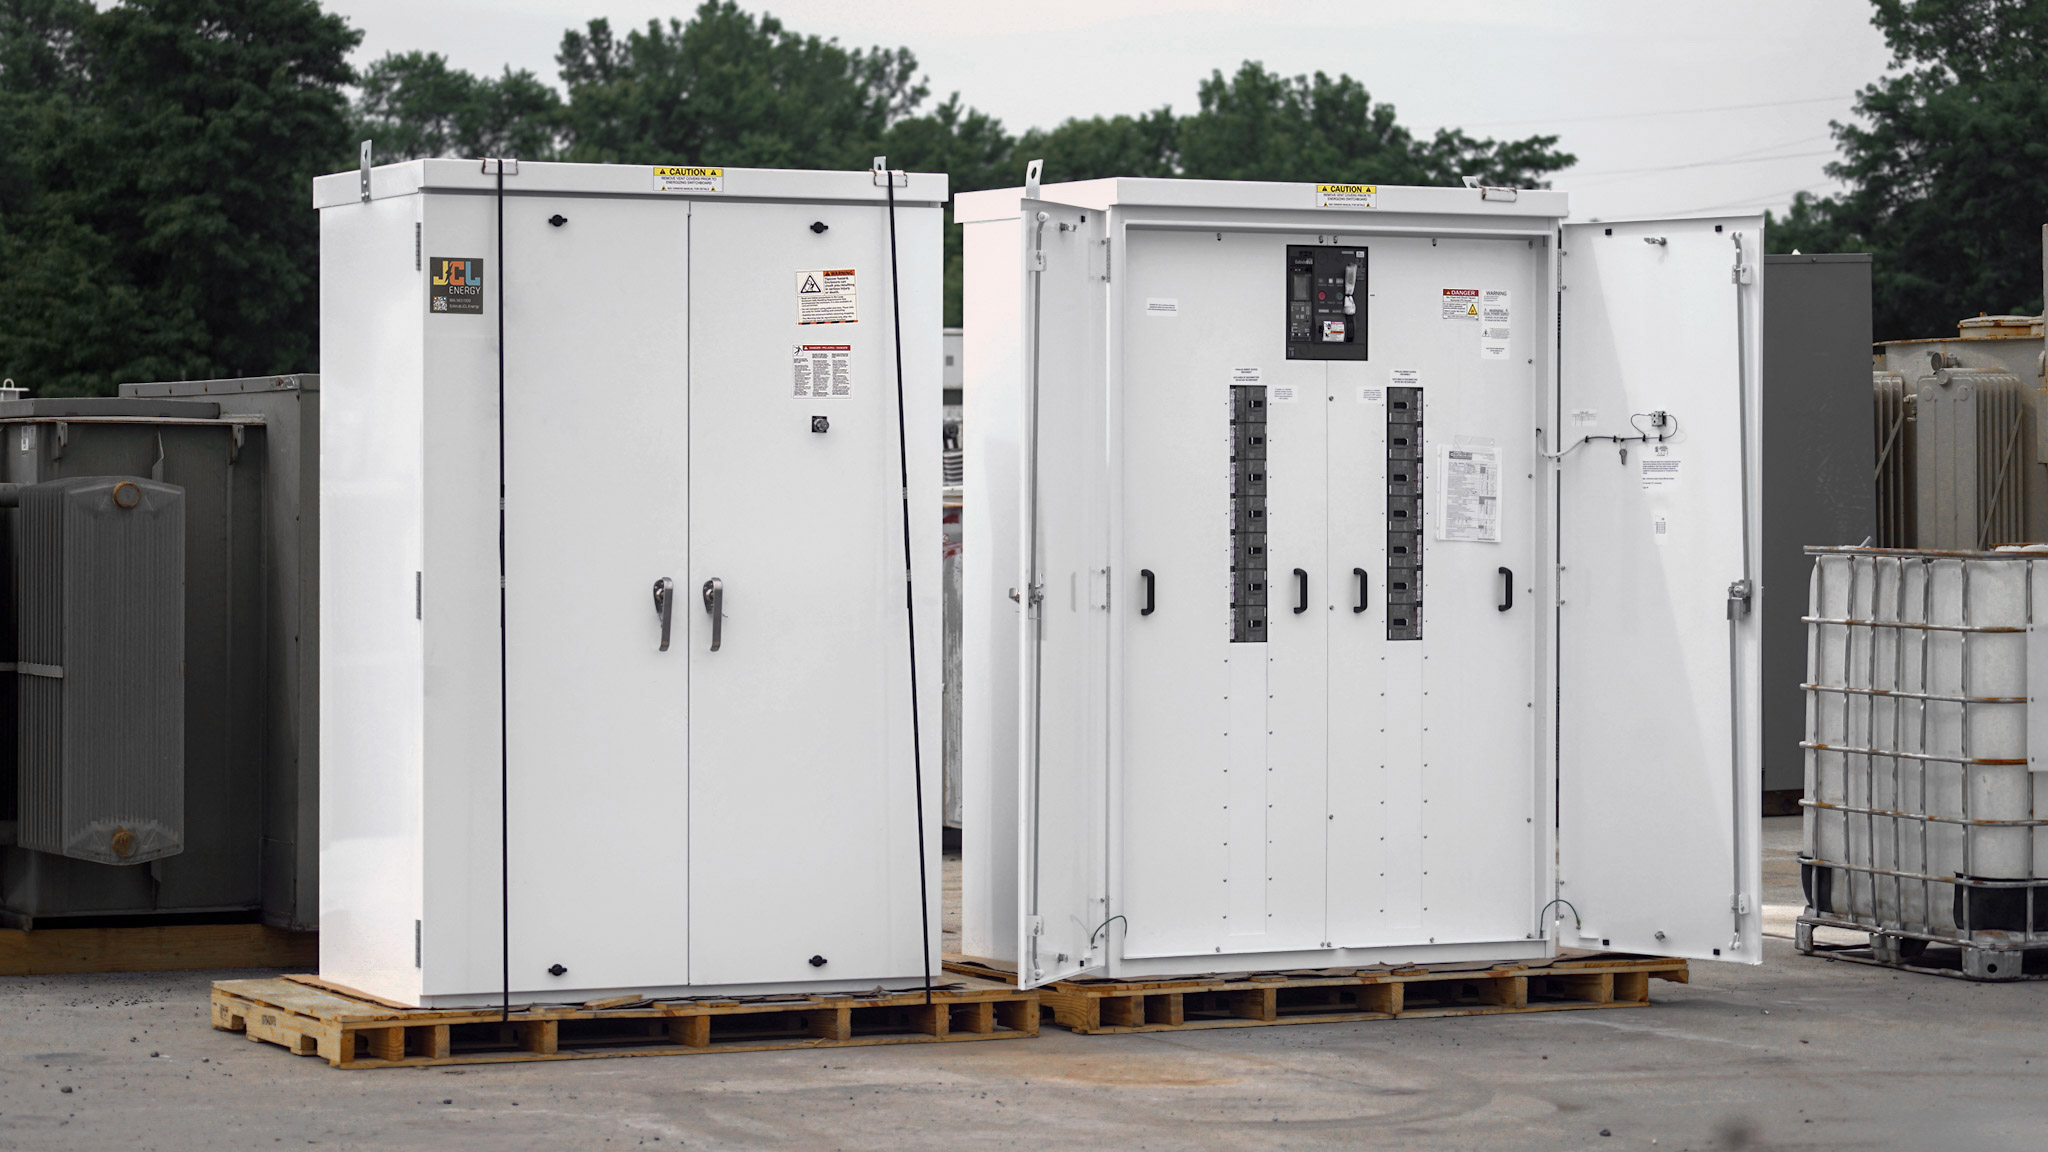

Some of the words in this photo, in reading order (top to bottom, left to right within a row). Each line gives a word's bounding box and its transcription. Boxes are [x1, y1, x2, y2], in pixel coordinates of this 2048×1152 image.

[670, 168, 706, 176] CAUTION
[433, 260, 480, 286] JCL
[448, 286, 481, 295] ENERGY
